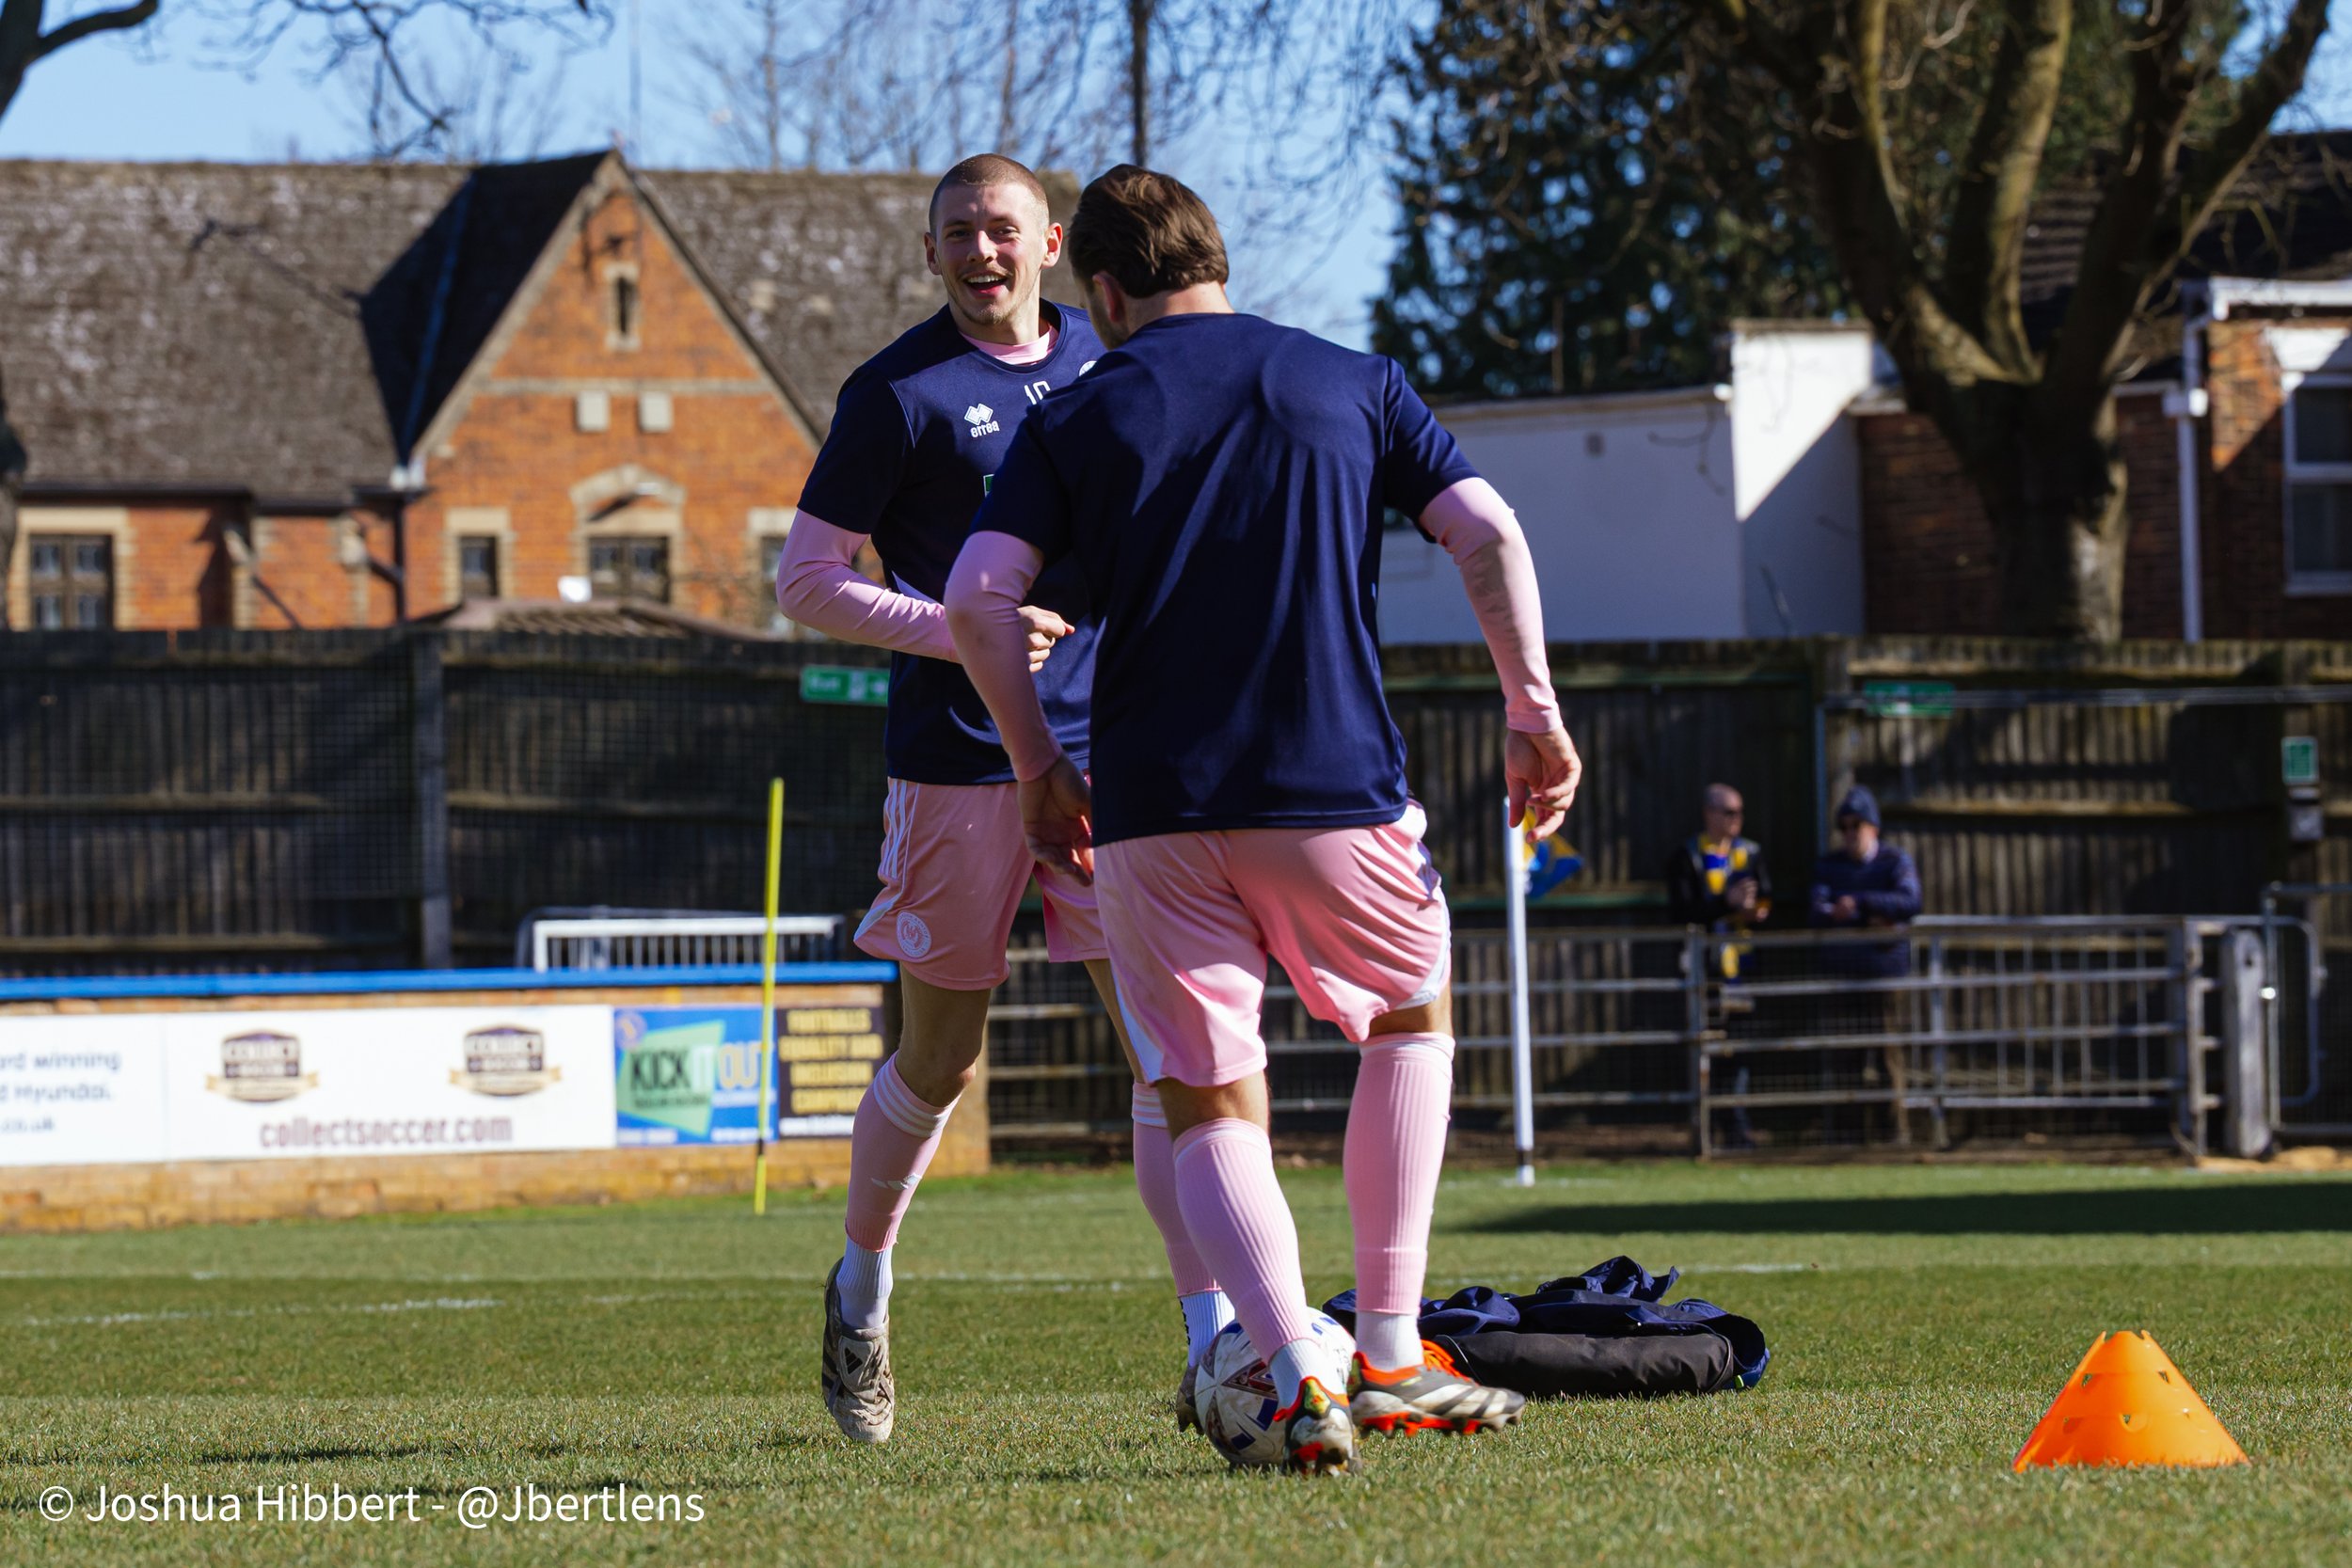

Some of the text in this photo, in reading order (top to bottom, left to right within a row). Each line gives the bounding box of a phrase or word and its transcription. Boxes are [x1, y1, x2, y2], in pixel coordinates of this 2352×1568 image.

[34, 1051, 122, 1073] winning
[630, 1050, 691, 1091] KICK
[260, 1117, 513, 1148] collectsoccer.com
